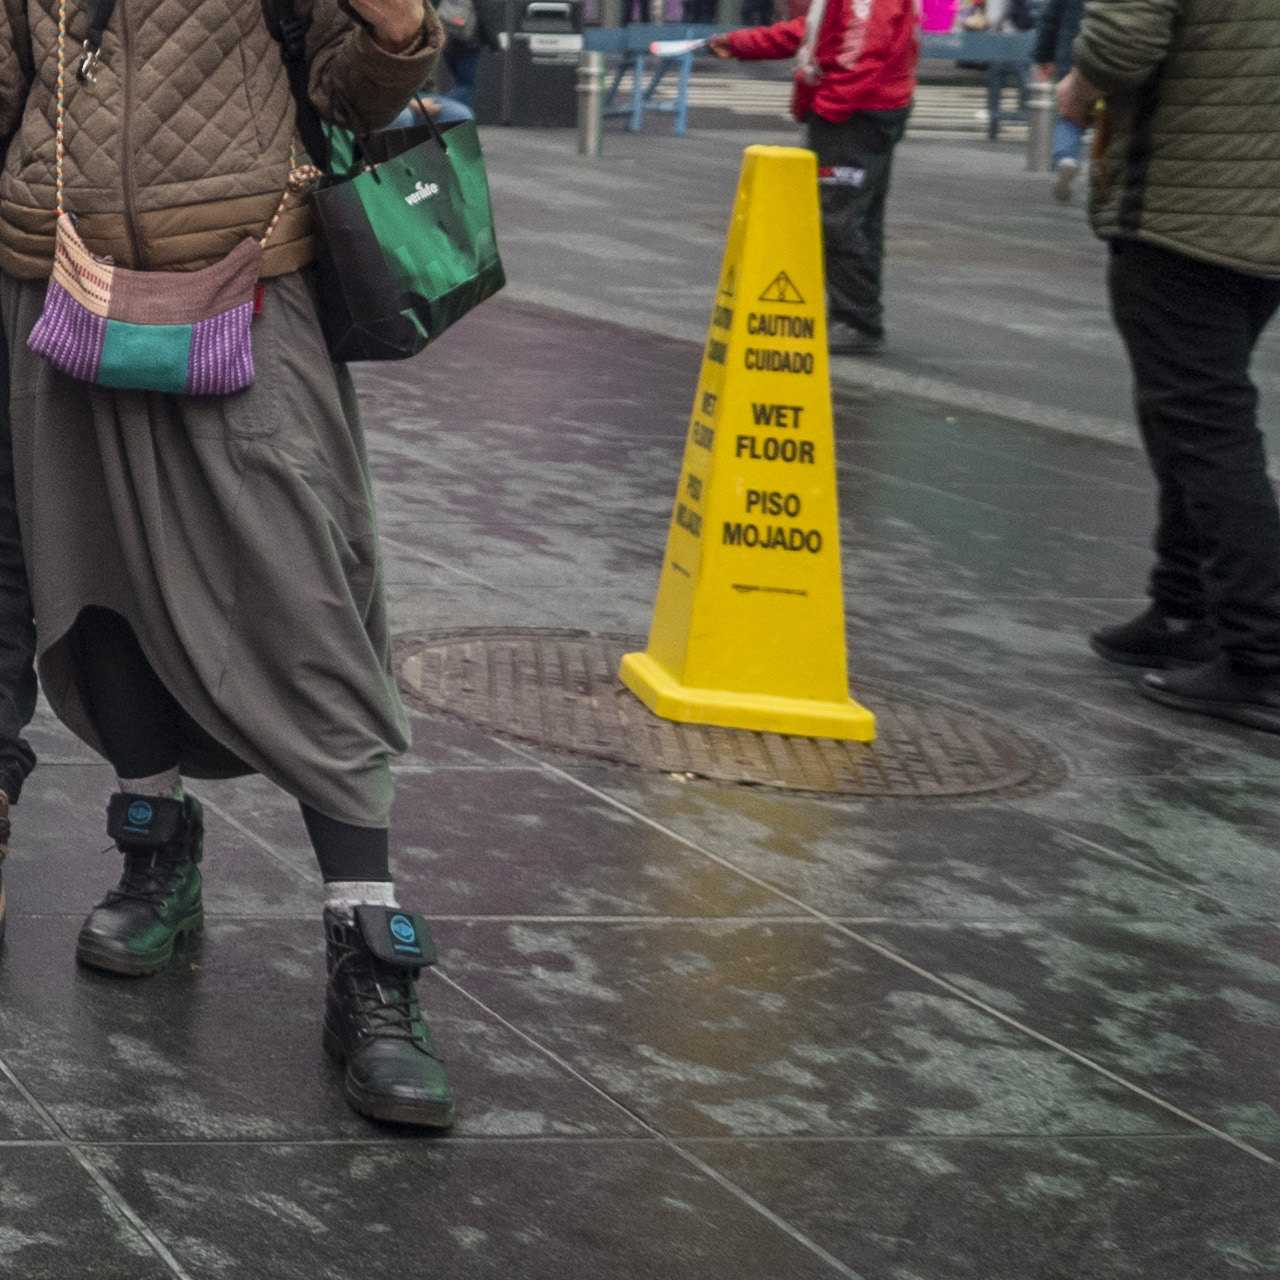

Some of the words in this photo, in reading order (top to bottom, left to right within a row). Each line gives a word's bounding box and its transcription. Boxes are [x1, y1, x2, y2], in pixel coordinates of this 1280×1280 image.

[747, 311, 815, 340] CAUTION
[744, 347, 814, 376] CUIDADO
[752, 403, 804, 429] WET
[735, 436, 815, 465] FLOOR
[745, 491, 801, 518] PISO
[722, 523, 822, 554] MOJADO
